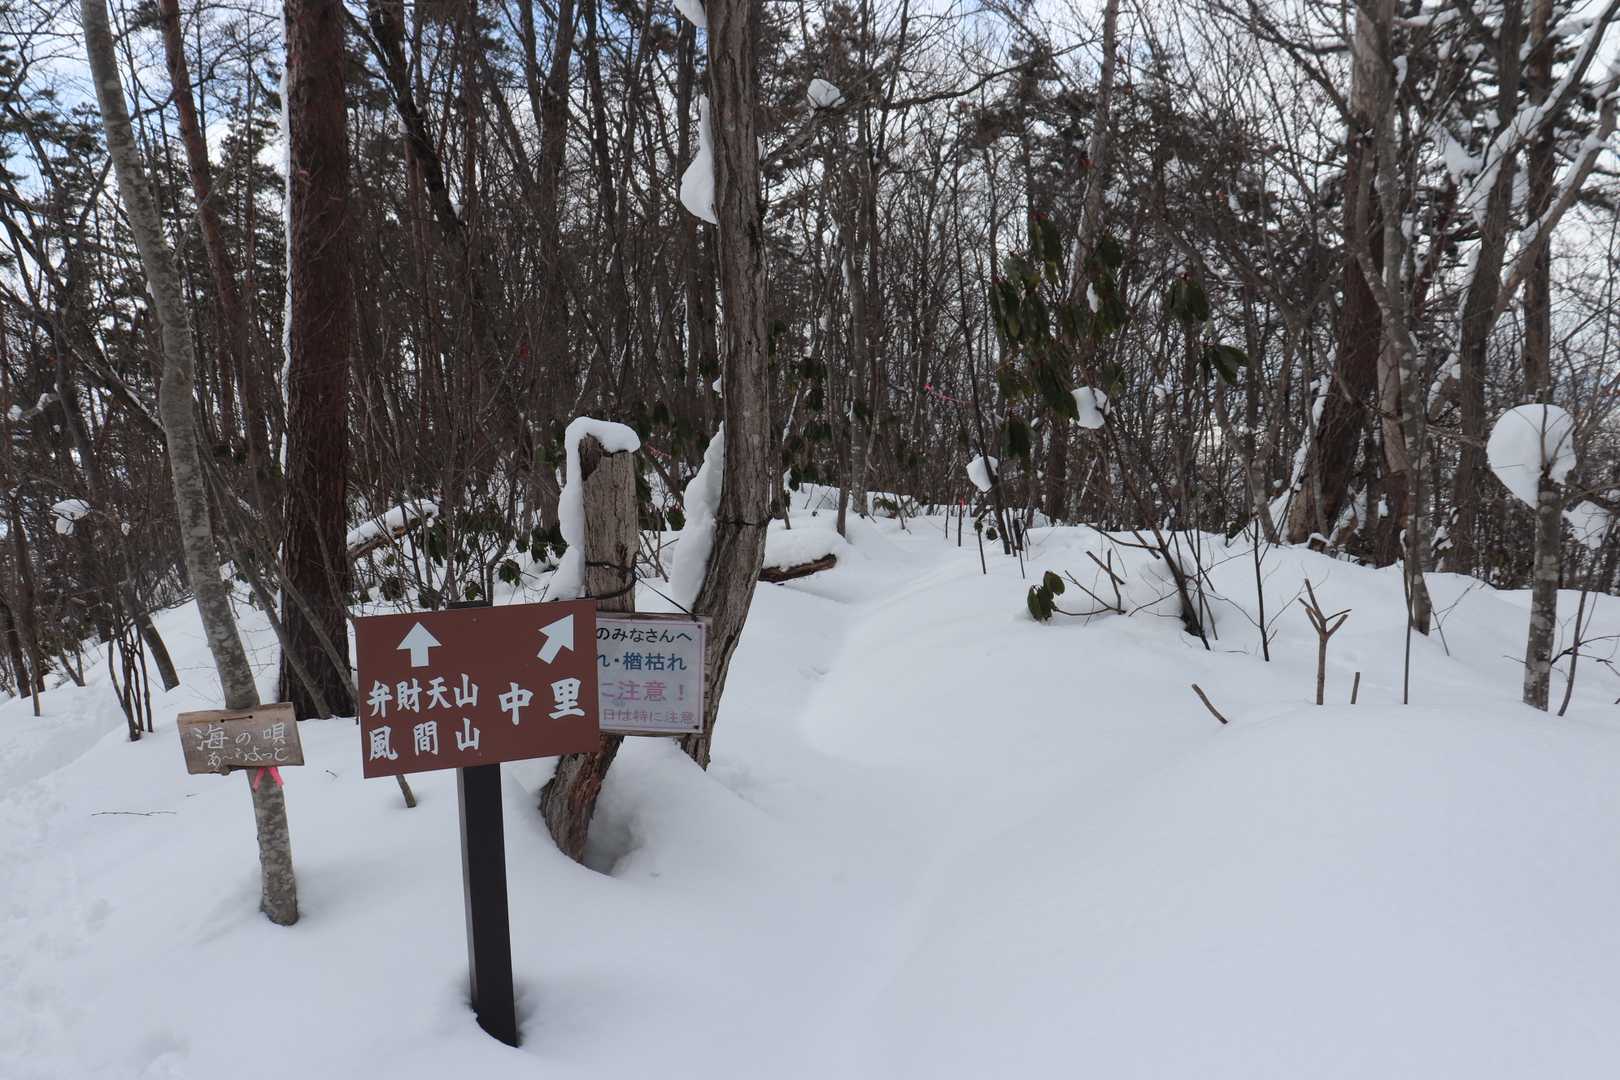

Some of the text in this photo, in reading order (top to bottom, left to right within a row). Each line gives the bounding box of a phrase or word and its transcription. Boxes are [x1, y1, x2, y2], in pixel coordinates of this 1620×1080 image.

[596, 627, 692, 643] のみなさんへ
[366, 673, 480, 718] 弁財天山
[498, 677, 585, 725] 中里
[193, 722, 286, 751] 海の唄
[369, 718, 481, 761] 風間山
